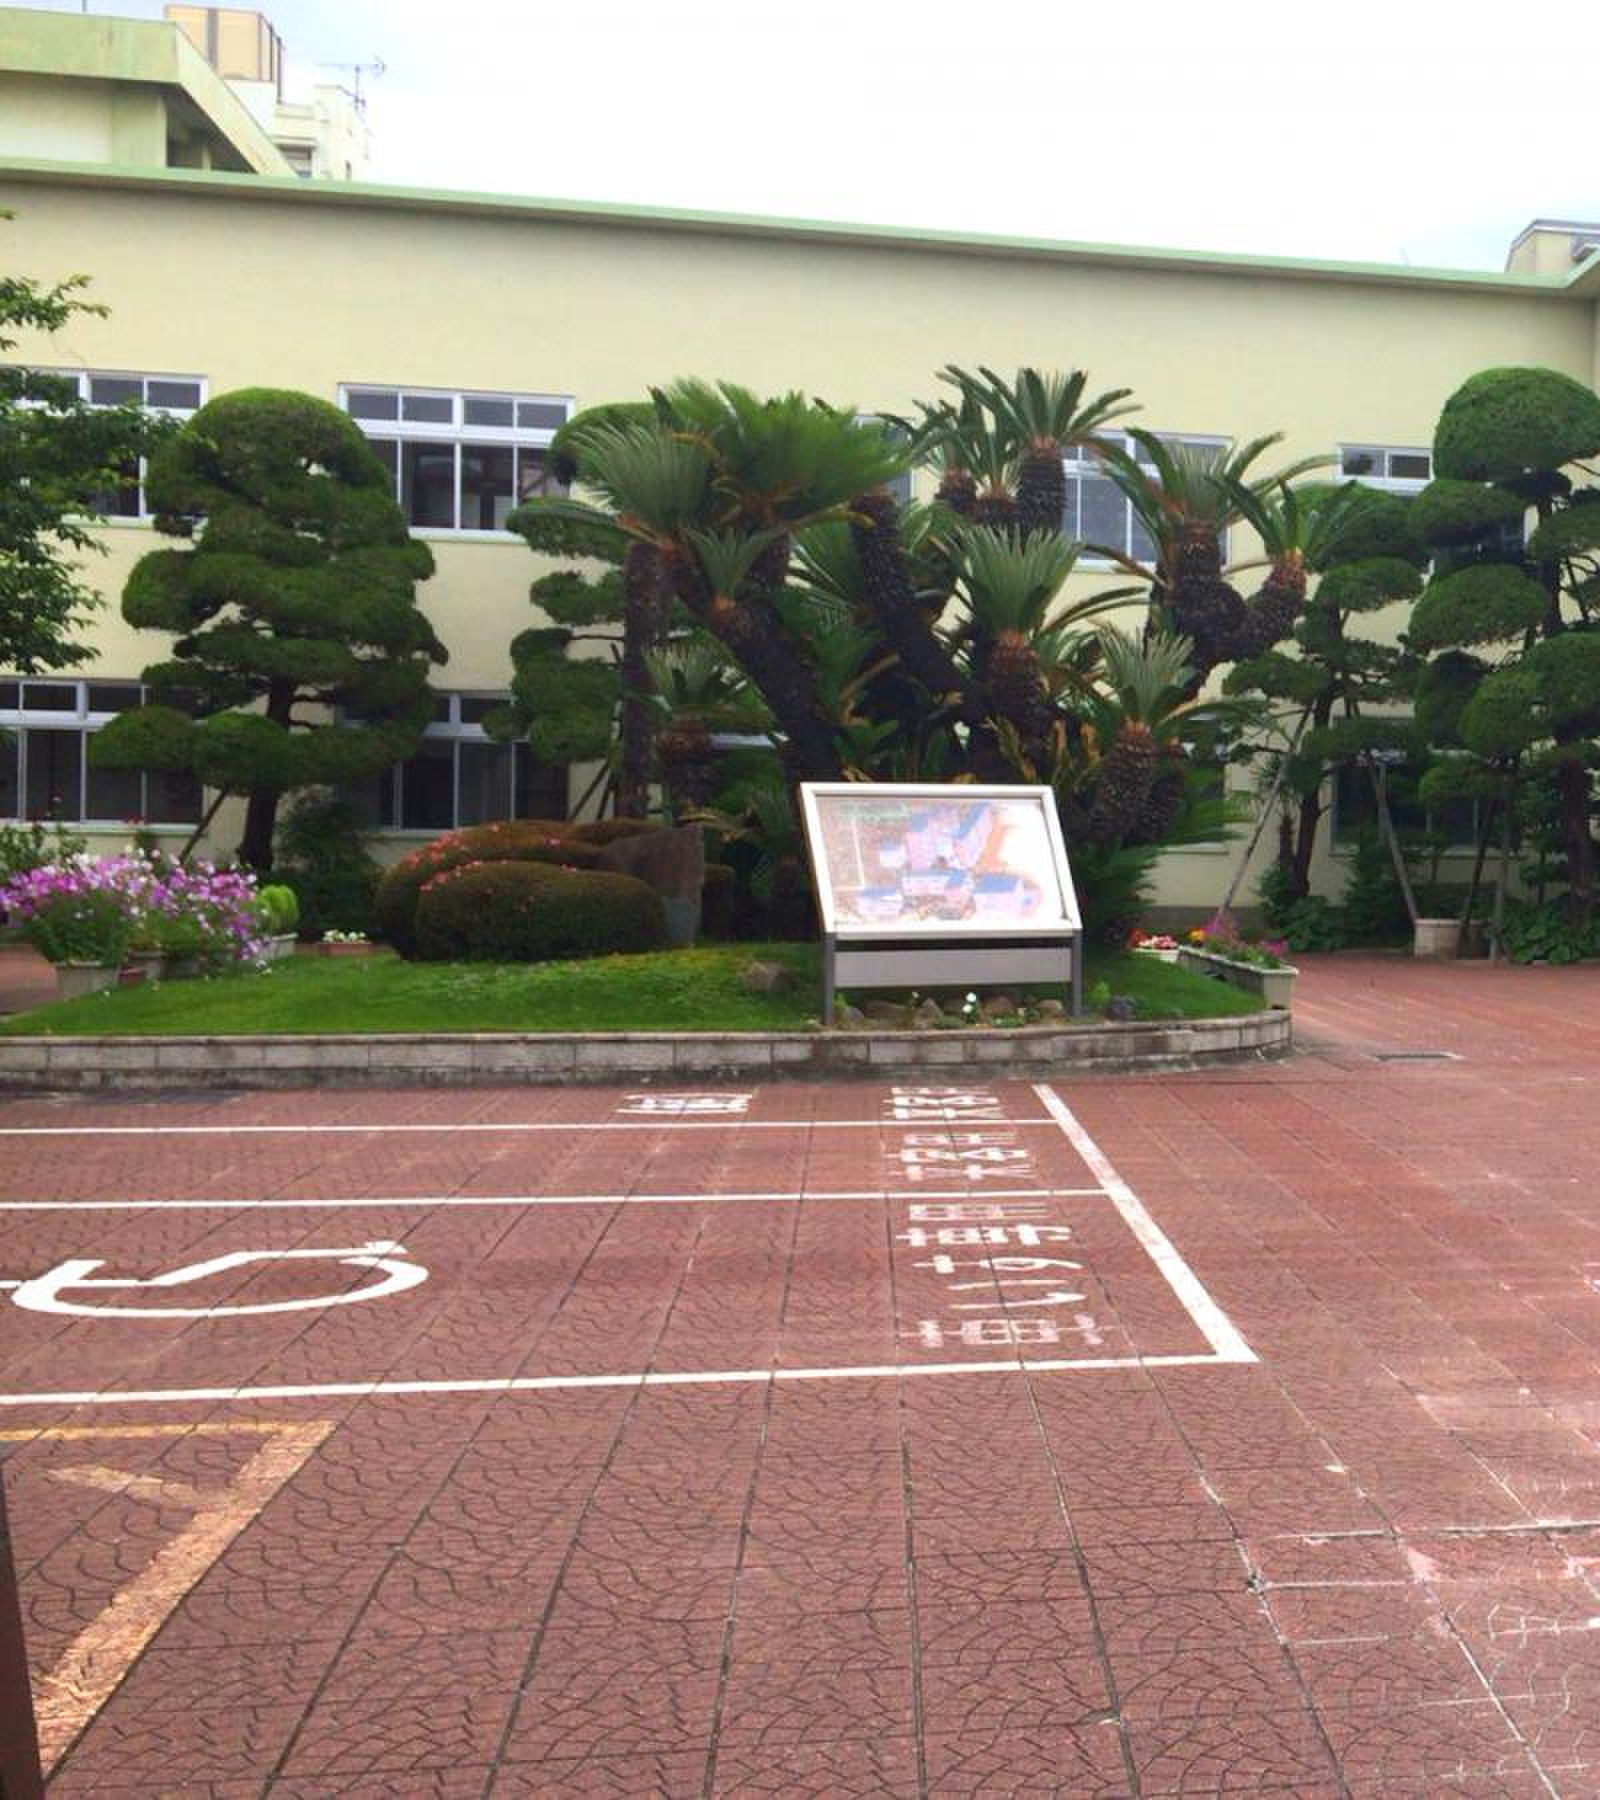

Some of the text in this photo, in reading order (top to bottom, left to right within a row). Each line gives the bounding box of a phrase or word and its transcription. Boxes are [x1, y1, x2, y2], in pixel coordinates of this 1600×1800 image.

[895, 1202, 1117, 1348] 車いす専用
